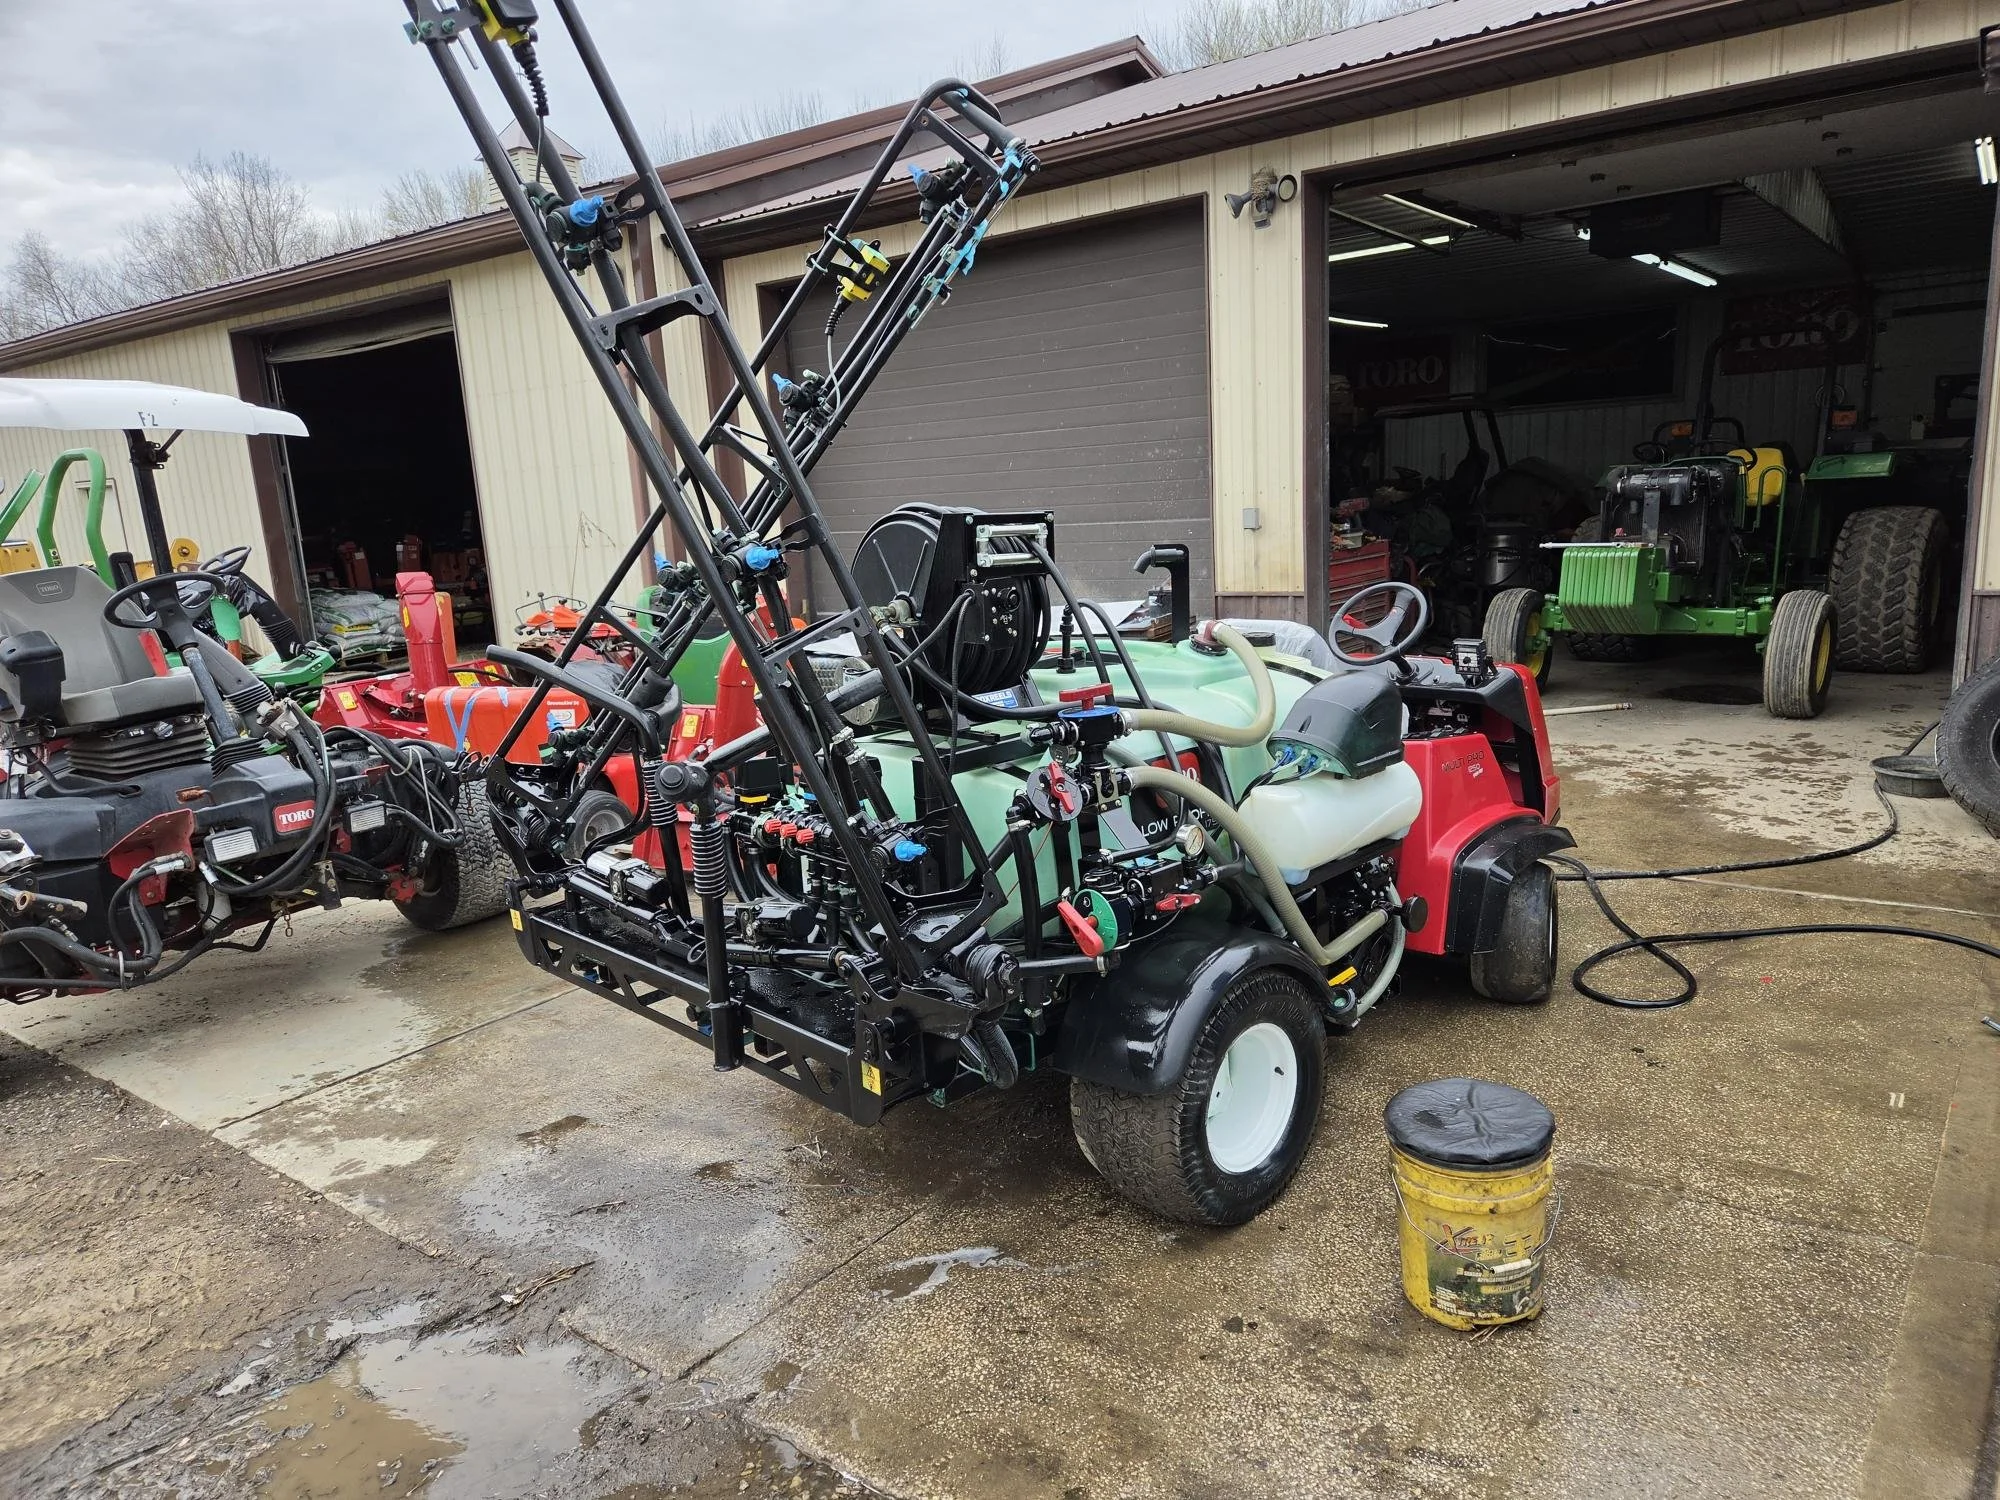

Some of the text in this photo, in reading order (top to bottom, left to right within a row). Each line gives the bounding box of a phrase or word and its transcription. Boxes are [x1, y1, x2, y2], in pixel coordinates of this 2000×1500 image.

[1357, 356, 1444, 388] TORO
[1467, 751, 1484, 764] PRO
[278, 808, 315, 824] TORO
[1141, 818, 1168, 837] LOW
